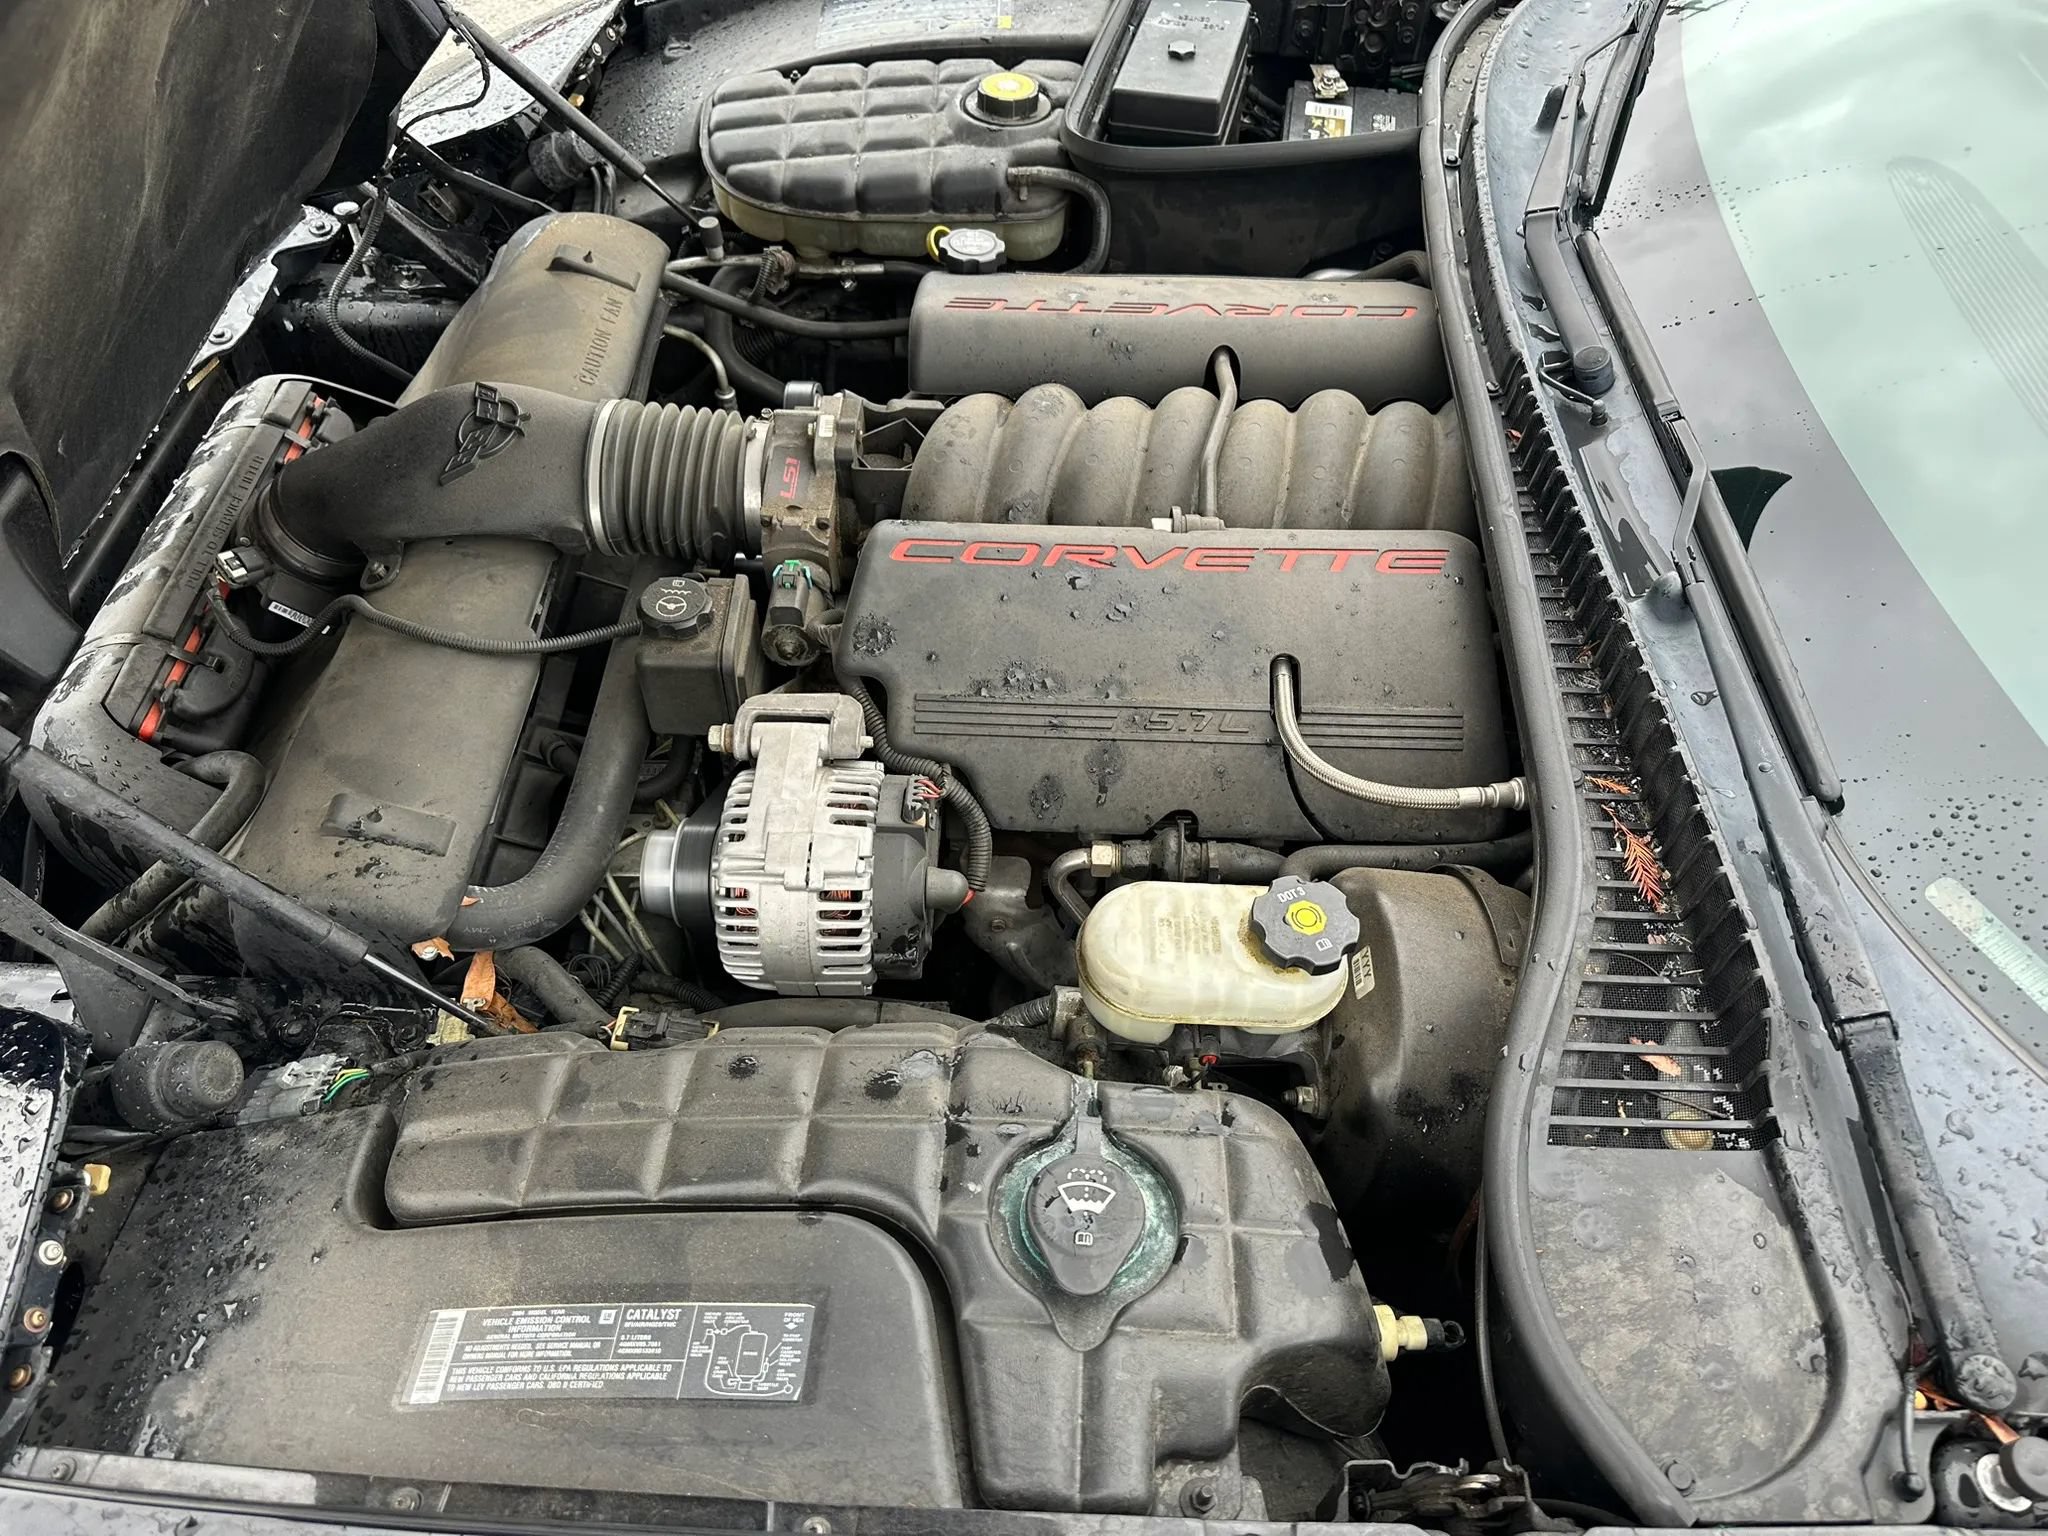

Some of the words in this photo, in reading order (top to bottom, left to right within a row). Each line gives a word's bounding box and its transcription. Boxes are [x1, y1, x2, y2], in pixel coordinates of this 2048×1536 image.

[943, 296, 1419, 319] CORVETTE
[578, 327, 613, 386] CAUTION
[600, 296, 624, 325] FAN
[780, 455, 801, 500] LS1
[184, 560, 210, 591] PULL
[202, 541, 218, 556] TO
[213, 495, 243, 539] SERVICE
[889, 537, 1452, 574] CORVETTE
[1276, 887, 1299, 904] DOT
[1297, 886, 1306, 896] 3
[1361, 946, 1372, 978] YYY
[482, 1317, 514, 1327] VEHICLE
[515, 1315, 554, 1325] EMISSION
[554, 1314, 591, 1324] CONTROL
[626, 1308, 682, 1320] CATALYST
[507, 1324, 563, 1333] INFORMATION
[472, 1343, 510, 1352] ADJUSTMENTS
[535, 1342, 546, 1350] SEE
[546, 1341, 569, 1350] SERVICE
[568, 1341, 592, 1349] MANUAL
[484, 1351, 507, 1359] MANUAL
[507, 1351, 519, 1359] FOR
[519, 1350, 535, 1358] MORE
[451, 1366, 467, 1375] THIS
[468, 1365, 495, 1375] VEHICLE
[495, 1364, 532, 1374] CONFORMS
[532, 1364, 542, 1373] TO
[543, 1364, 556, 1373] U.S.
[558, 1364, 572, 1372] EPA
[572, 1363, 619, 1372] REGULATIONS
[619, 1363, 661, 1372] APPLICABLE
[661, 1363, 673, 1372] TO
[449, 1374, 464, 1384] NEW
[464, 1373, 505, 1383] PASSENGER
[504, 1373, 522, 1382] CARS
[522, 1372, 539, 1381] AND
[538, 1372, 578, 1381] CALIFORNIA
[578, 1371, 625, 1380] REGULATIONS
[625, 1371, 668, 1381] APPLICABLE
[456, 1382, 472, 1391] NEW
[472, 1382, 485, 1391] LEV
[485, 1381, 526, 1390] PASSENGER
[526, 1381, 545, 1389] CARS.
[546, 1380, 561, 1389] OBD
[569, 1379, 604, 1388] CERTIFIED
